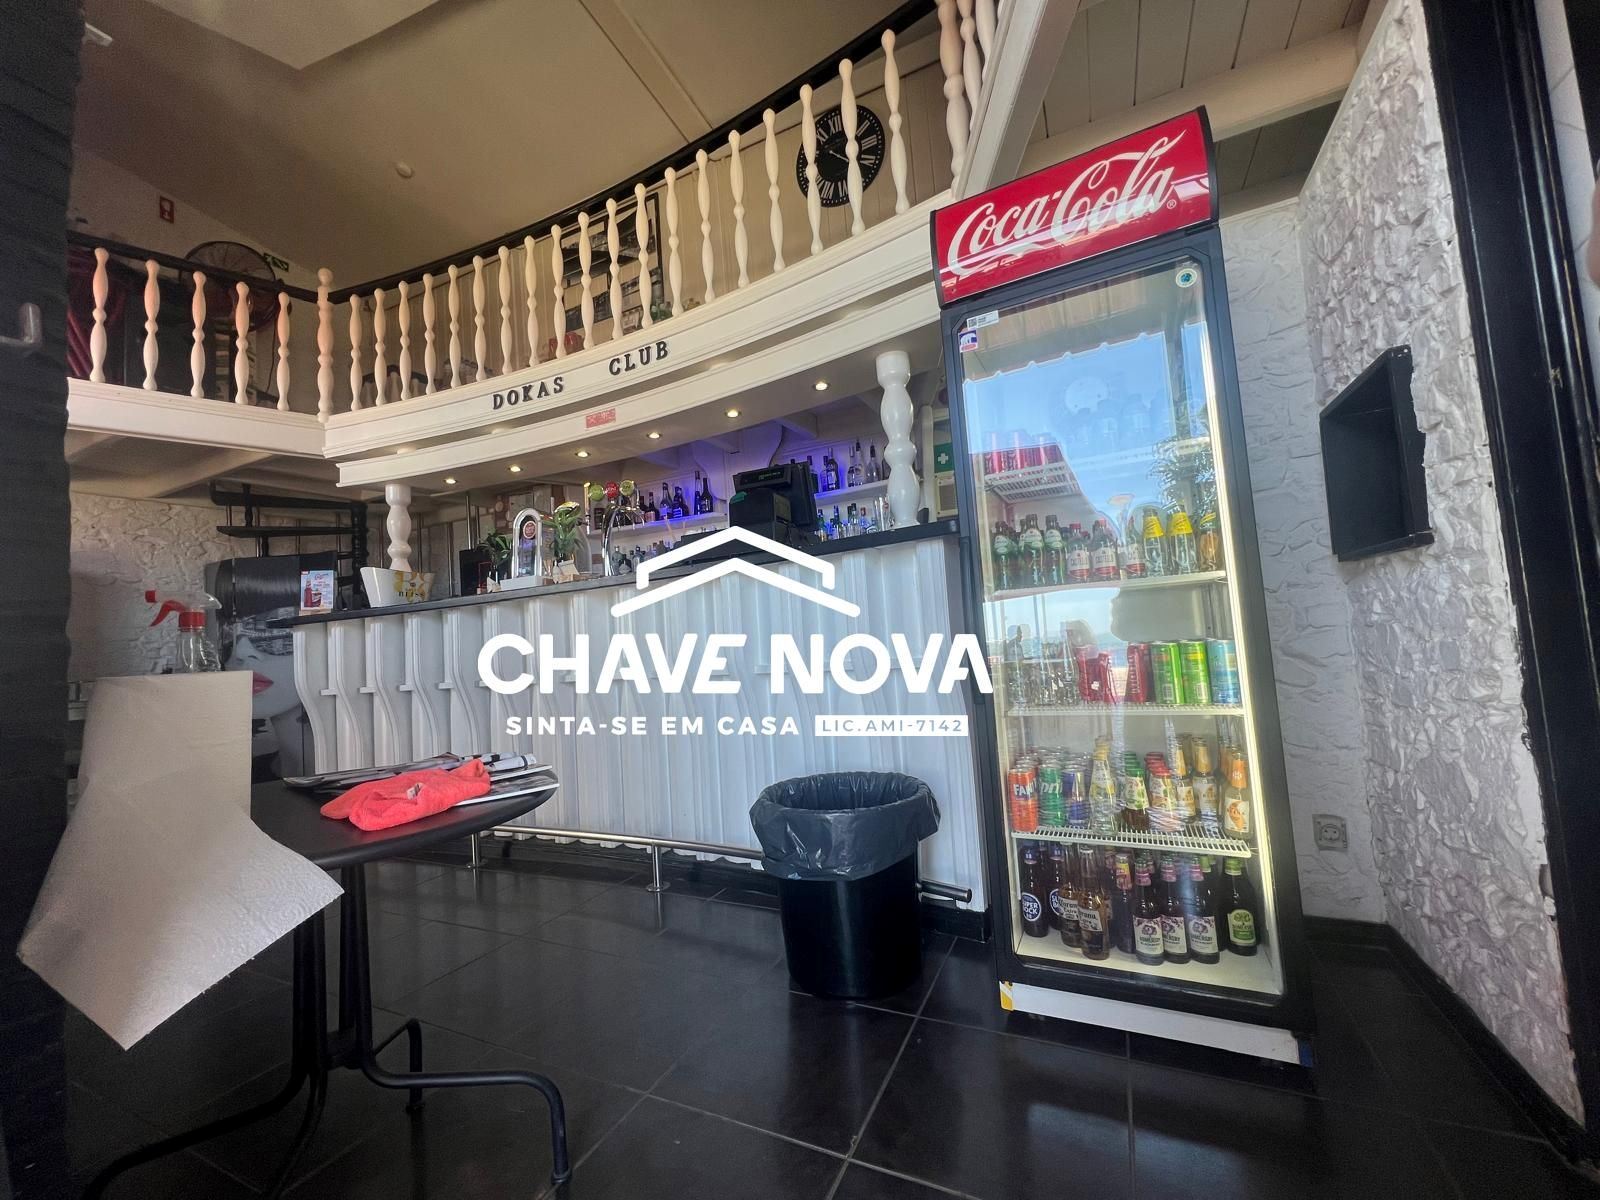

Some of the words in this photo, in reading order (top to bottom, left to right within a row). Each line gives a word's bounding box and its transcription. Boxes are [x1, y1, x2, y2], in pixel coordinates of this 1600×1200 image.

[947, 129, 1186, 277] Coca-Cola
[492, 376, 564, 410] DOKAS
[608, 340, 669, 376] CLUB
